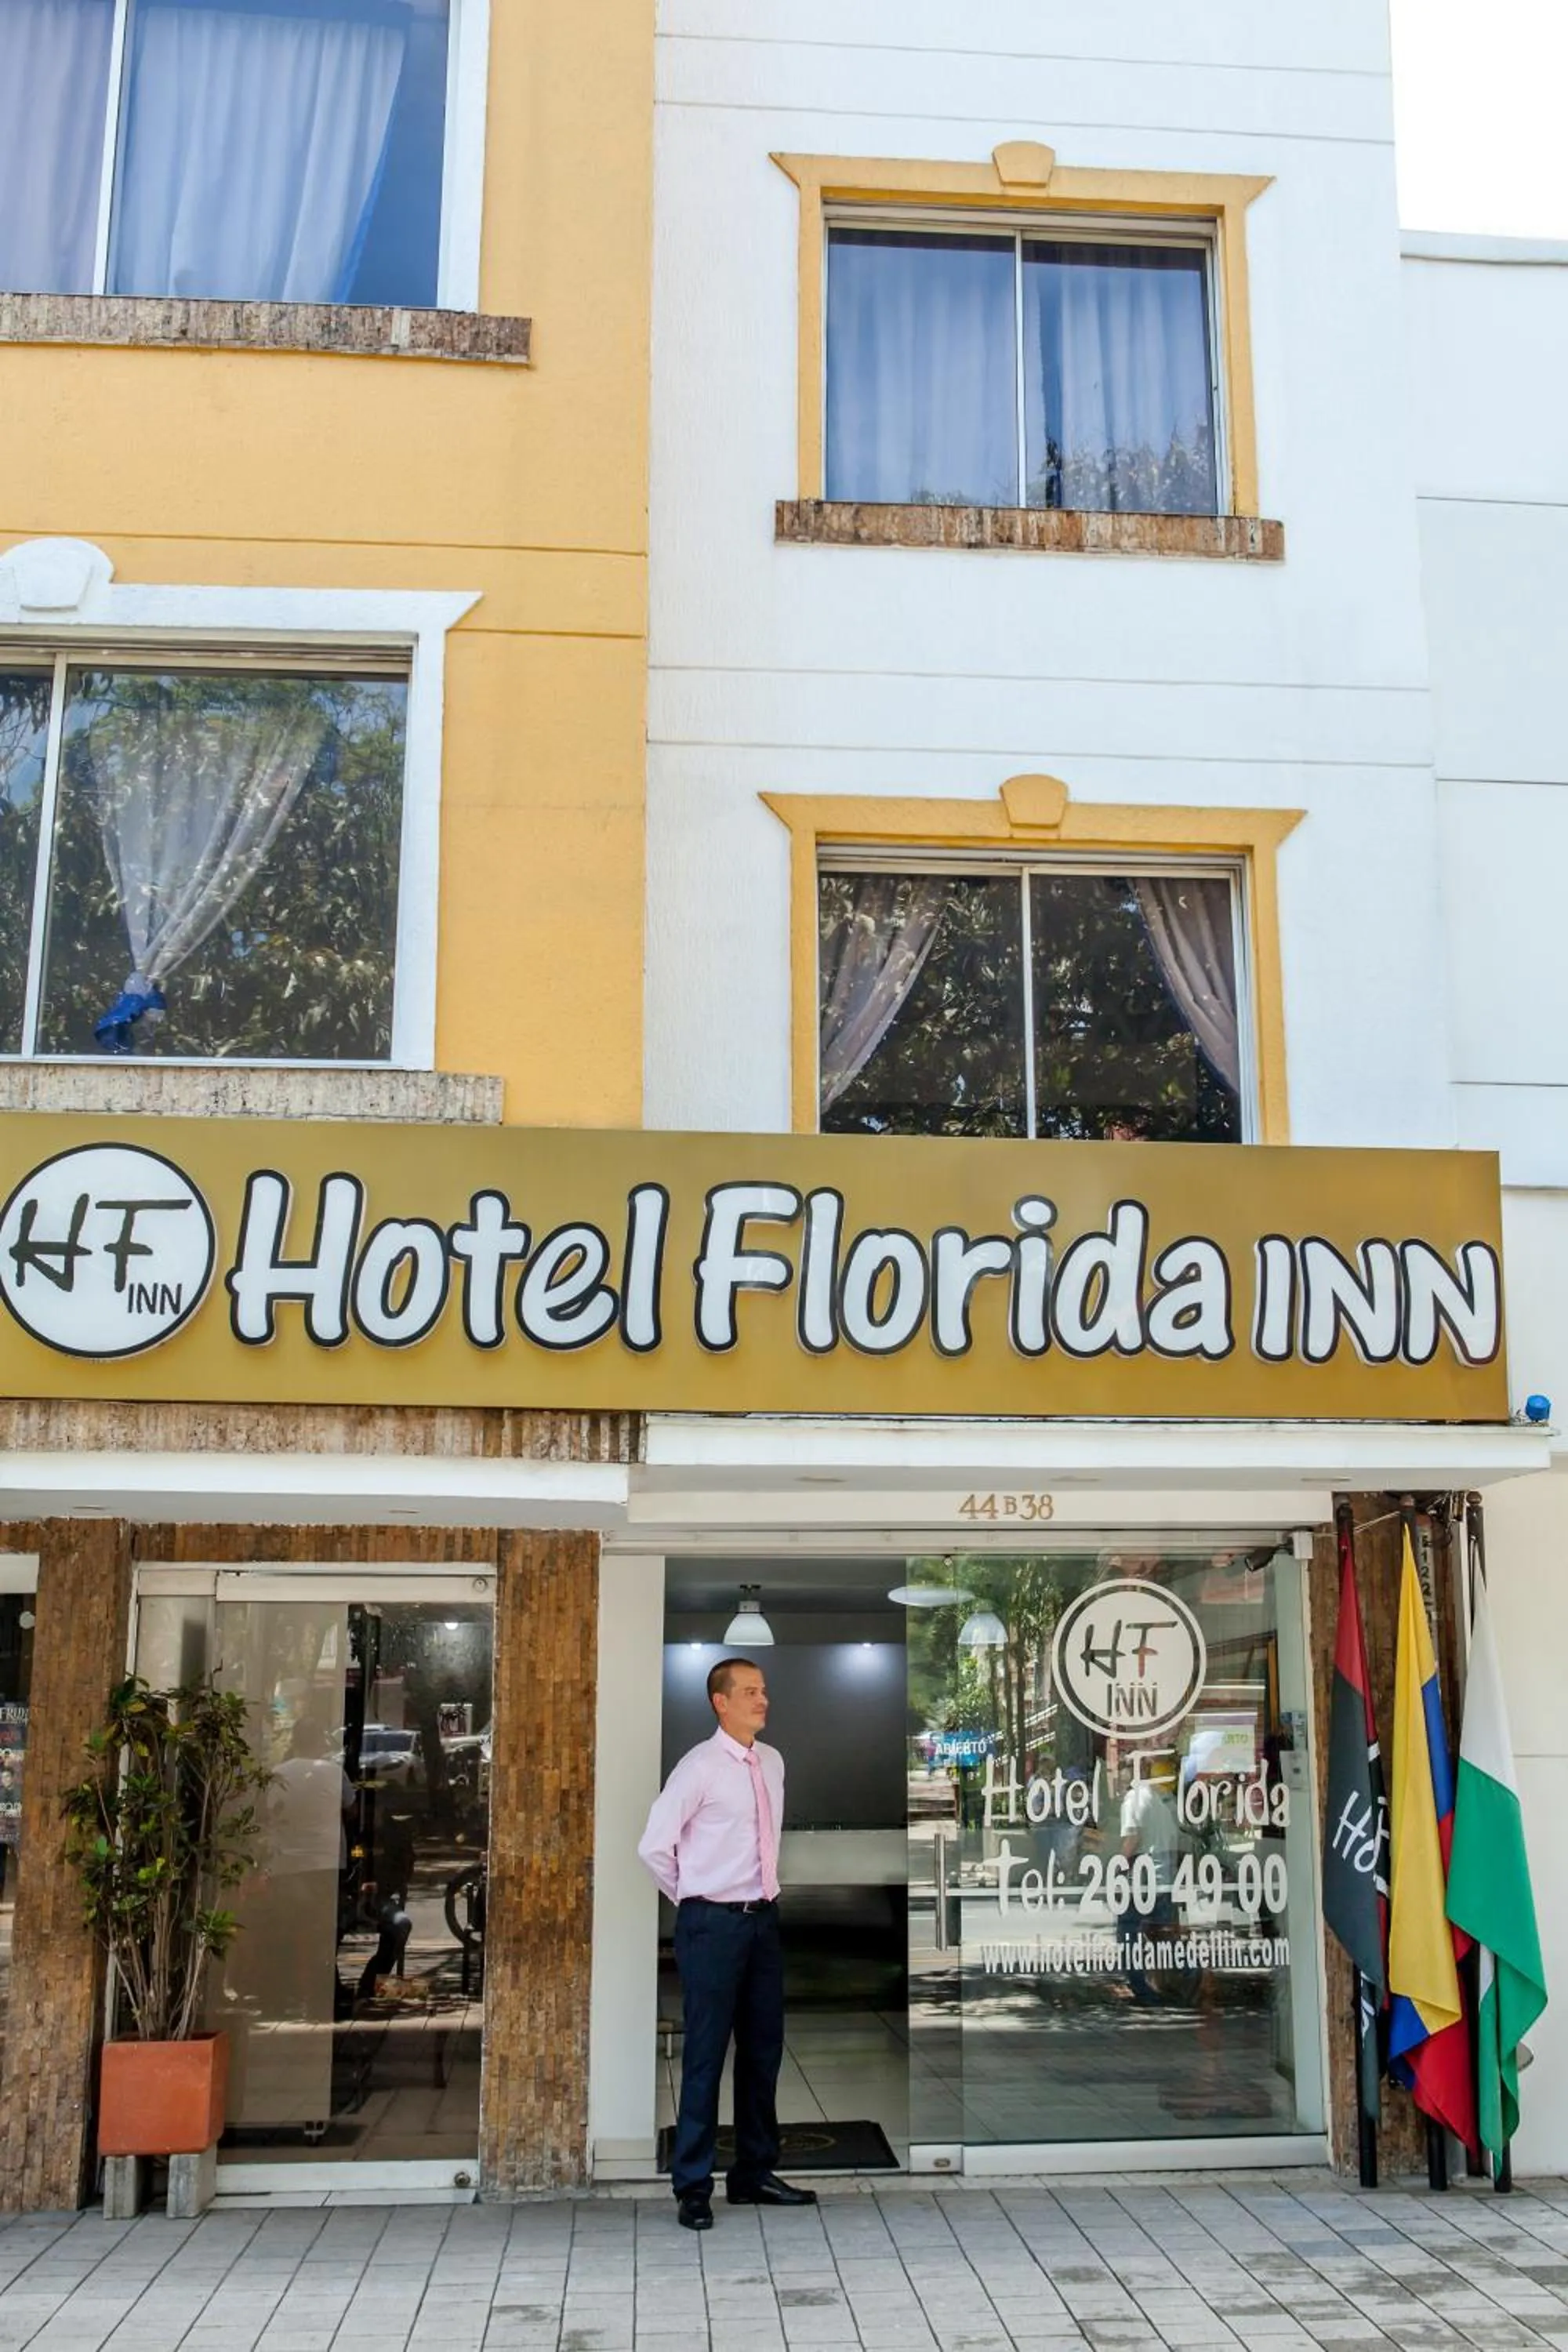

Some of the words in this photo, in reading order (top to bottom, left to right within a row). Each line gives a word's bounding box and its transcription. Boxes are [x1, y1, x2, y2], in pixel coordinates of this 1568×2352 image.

[225, 1169, 670, 1352] Hotel
[693, 1180, 1236, 1361] Florida
[1254, 1232, 1504, 1367] INN
[127, 1282, 183, 1316] INN
[1107, 1682, 1158, 1718] INN
[982, 1754, 1101, 1828] Hotel
[1124, 1749, 1291, 1828] Florida
